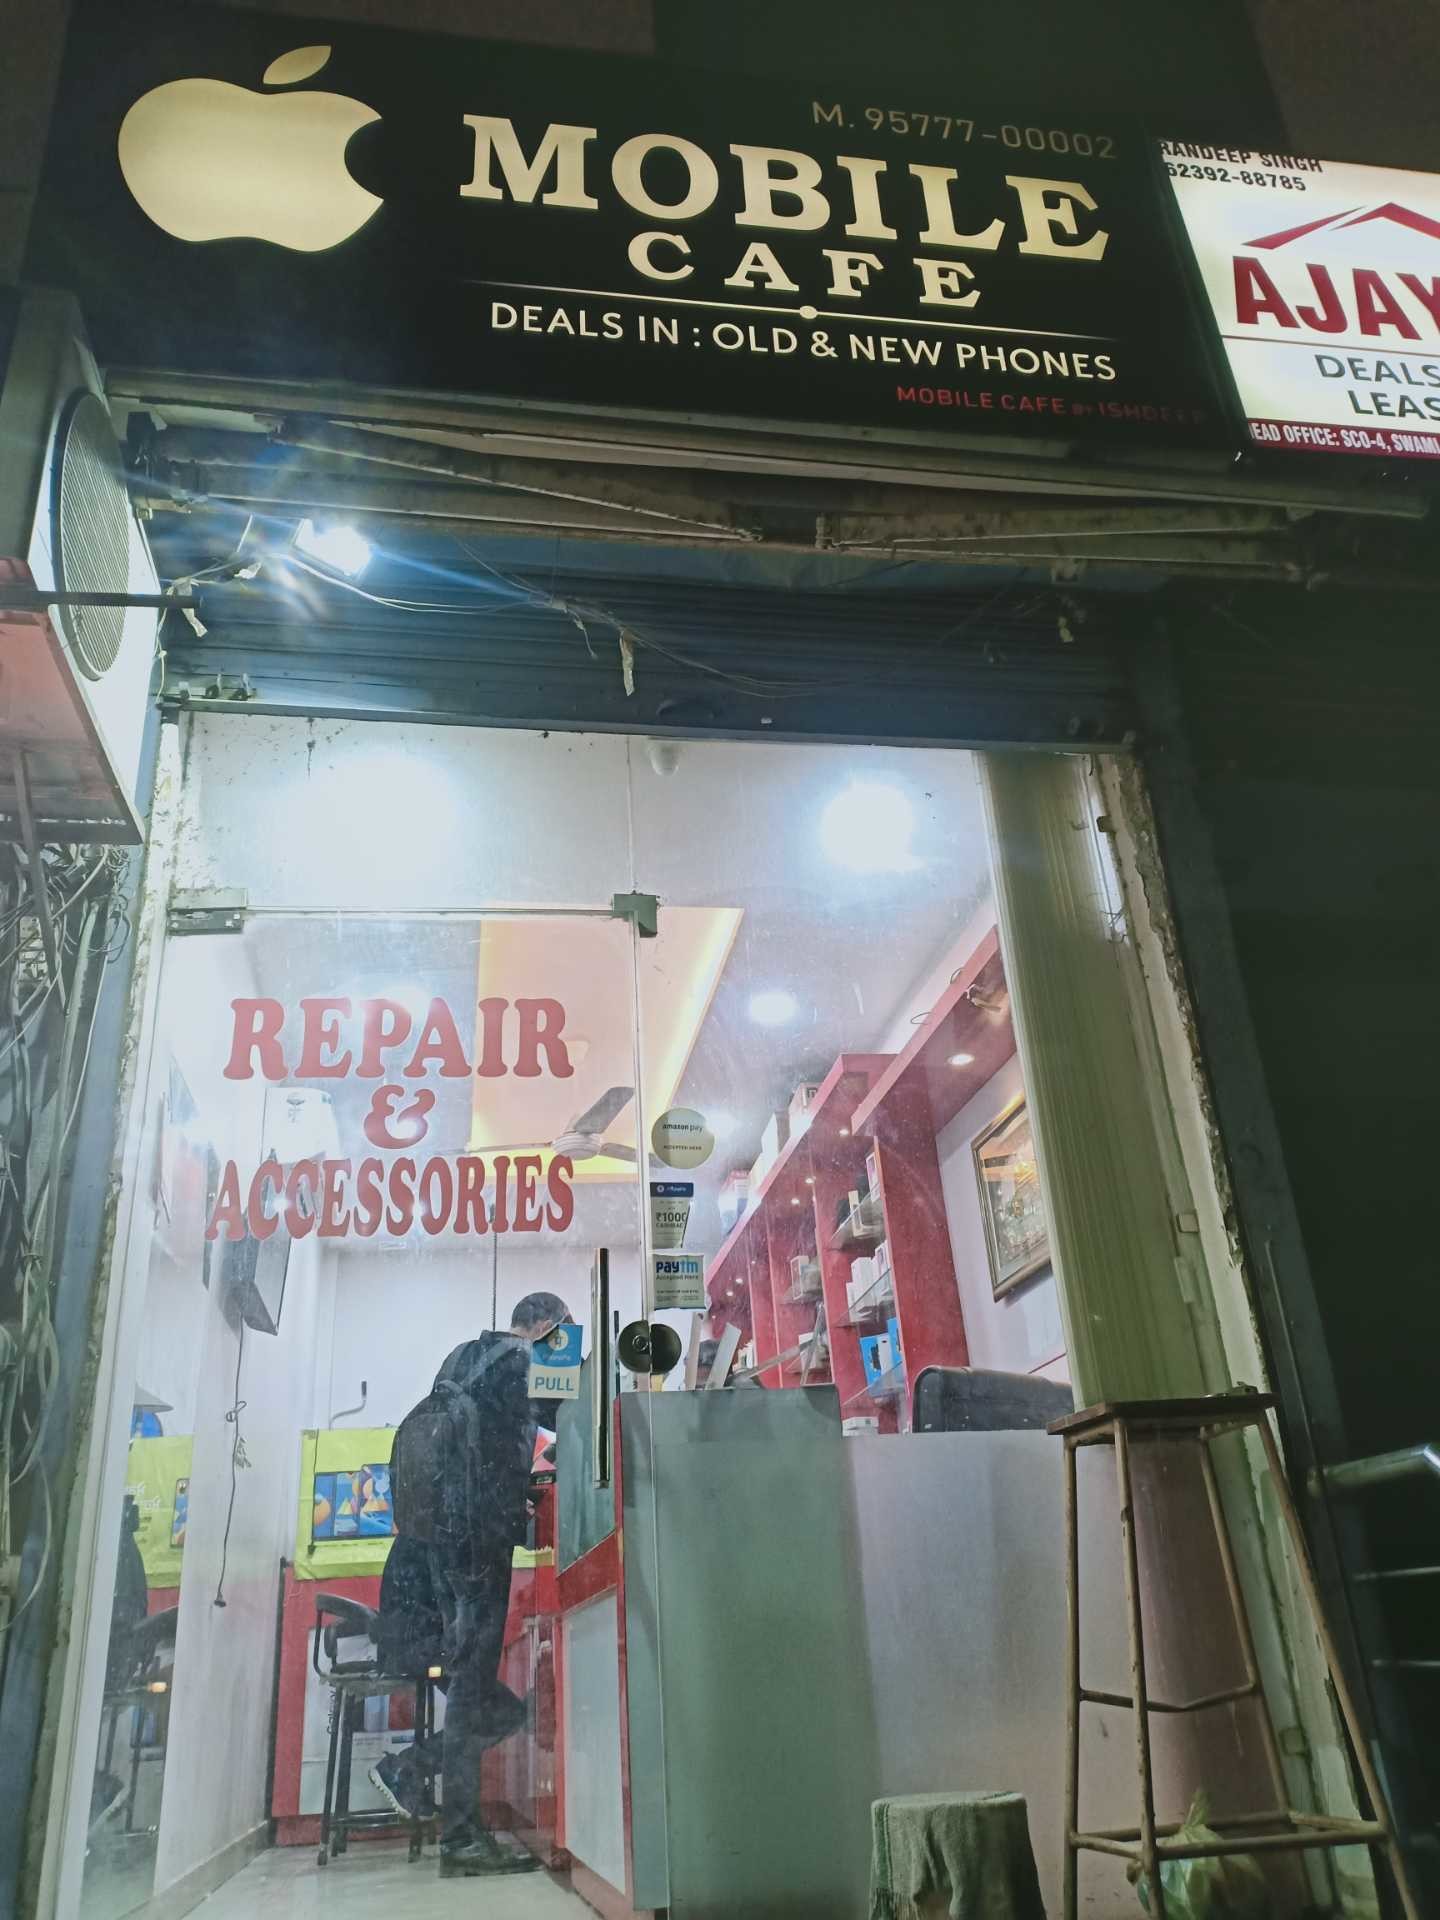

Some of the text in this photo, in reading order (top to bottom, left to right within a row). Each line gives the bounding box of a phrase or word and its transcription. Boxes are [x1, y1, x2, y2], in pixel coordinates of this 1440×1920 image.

[811, 101, 1117, 160] M. 95777-00002
[459, 113, 1109, 261] MOBILE
[1167, 162, 1306, 191] 62392-88785
[1262, 153, 1323, 173] SINGH
[627, 231, 981, 308] CAFE
[1233, 256, 1440, 340] AJAY
[491, 302, 625, 340] DEALS
[637, 315, 679, 345] IN
[711, 322, 798, 355] OLD
[809, 332, 838, 359] &
[849, 335, 942, 367] NEW
[957, 344, 1116, 381] PHONES
[1315, 354, 1440, 388] DEALS
[896, 386, 993, 409] MOBILE
[1000, 393, 1065, 416] CAFE
[1283, 426, 1340, 447] OFFICE:
[220, 997, 575, 1081] REPAIR
[363, 1085, 437, 1150] &
[204, 1154, 575, 1242] ACCESSORIES
[535, 1376, 574, 1392] PULL
